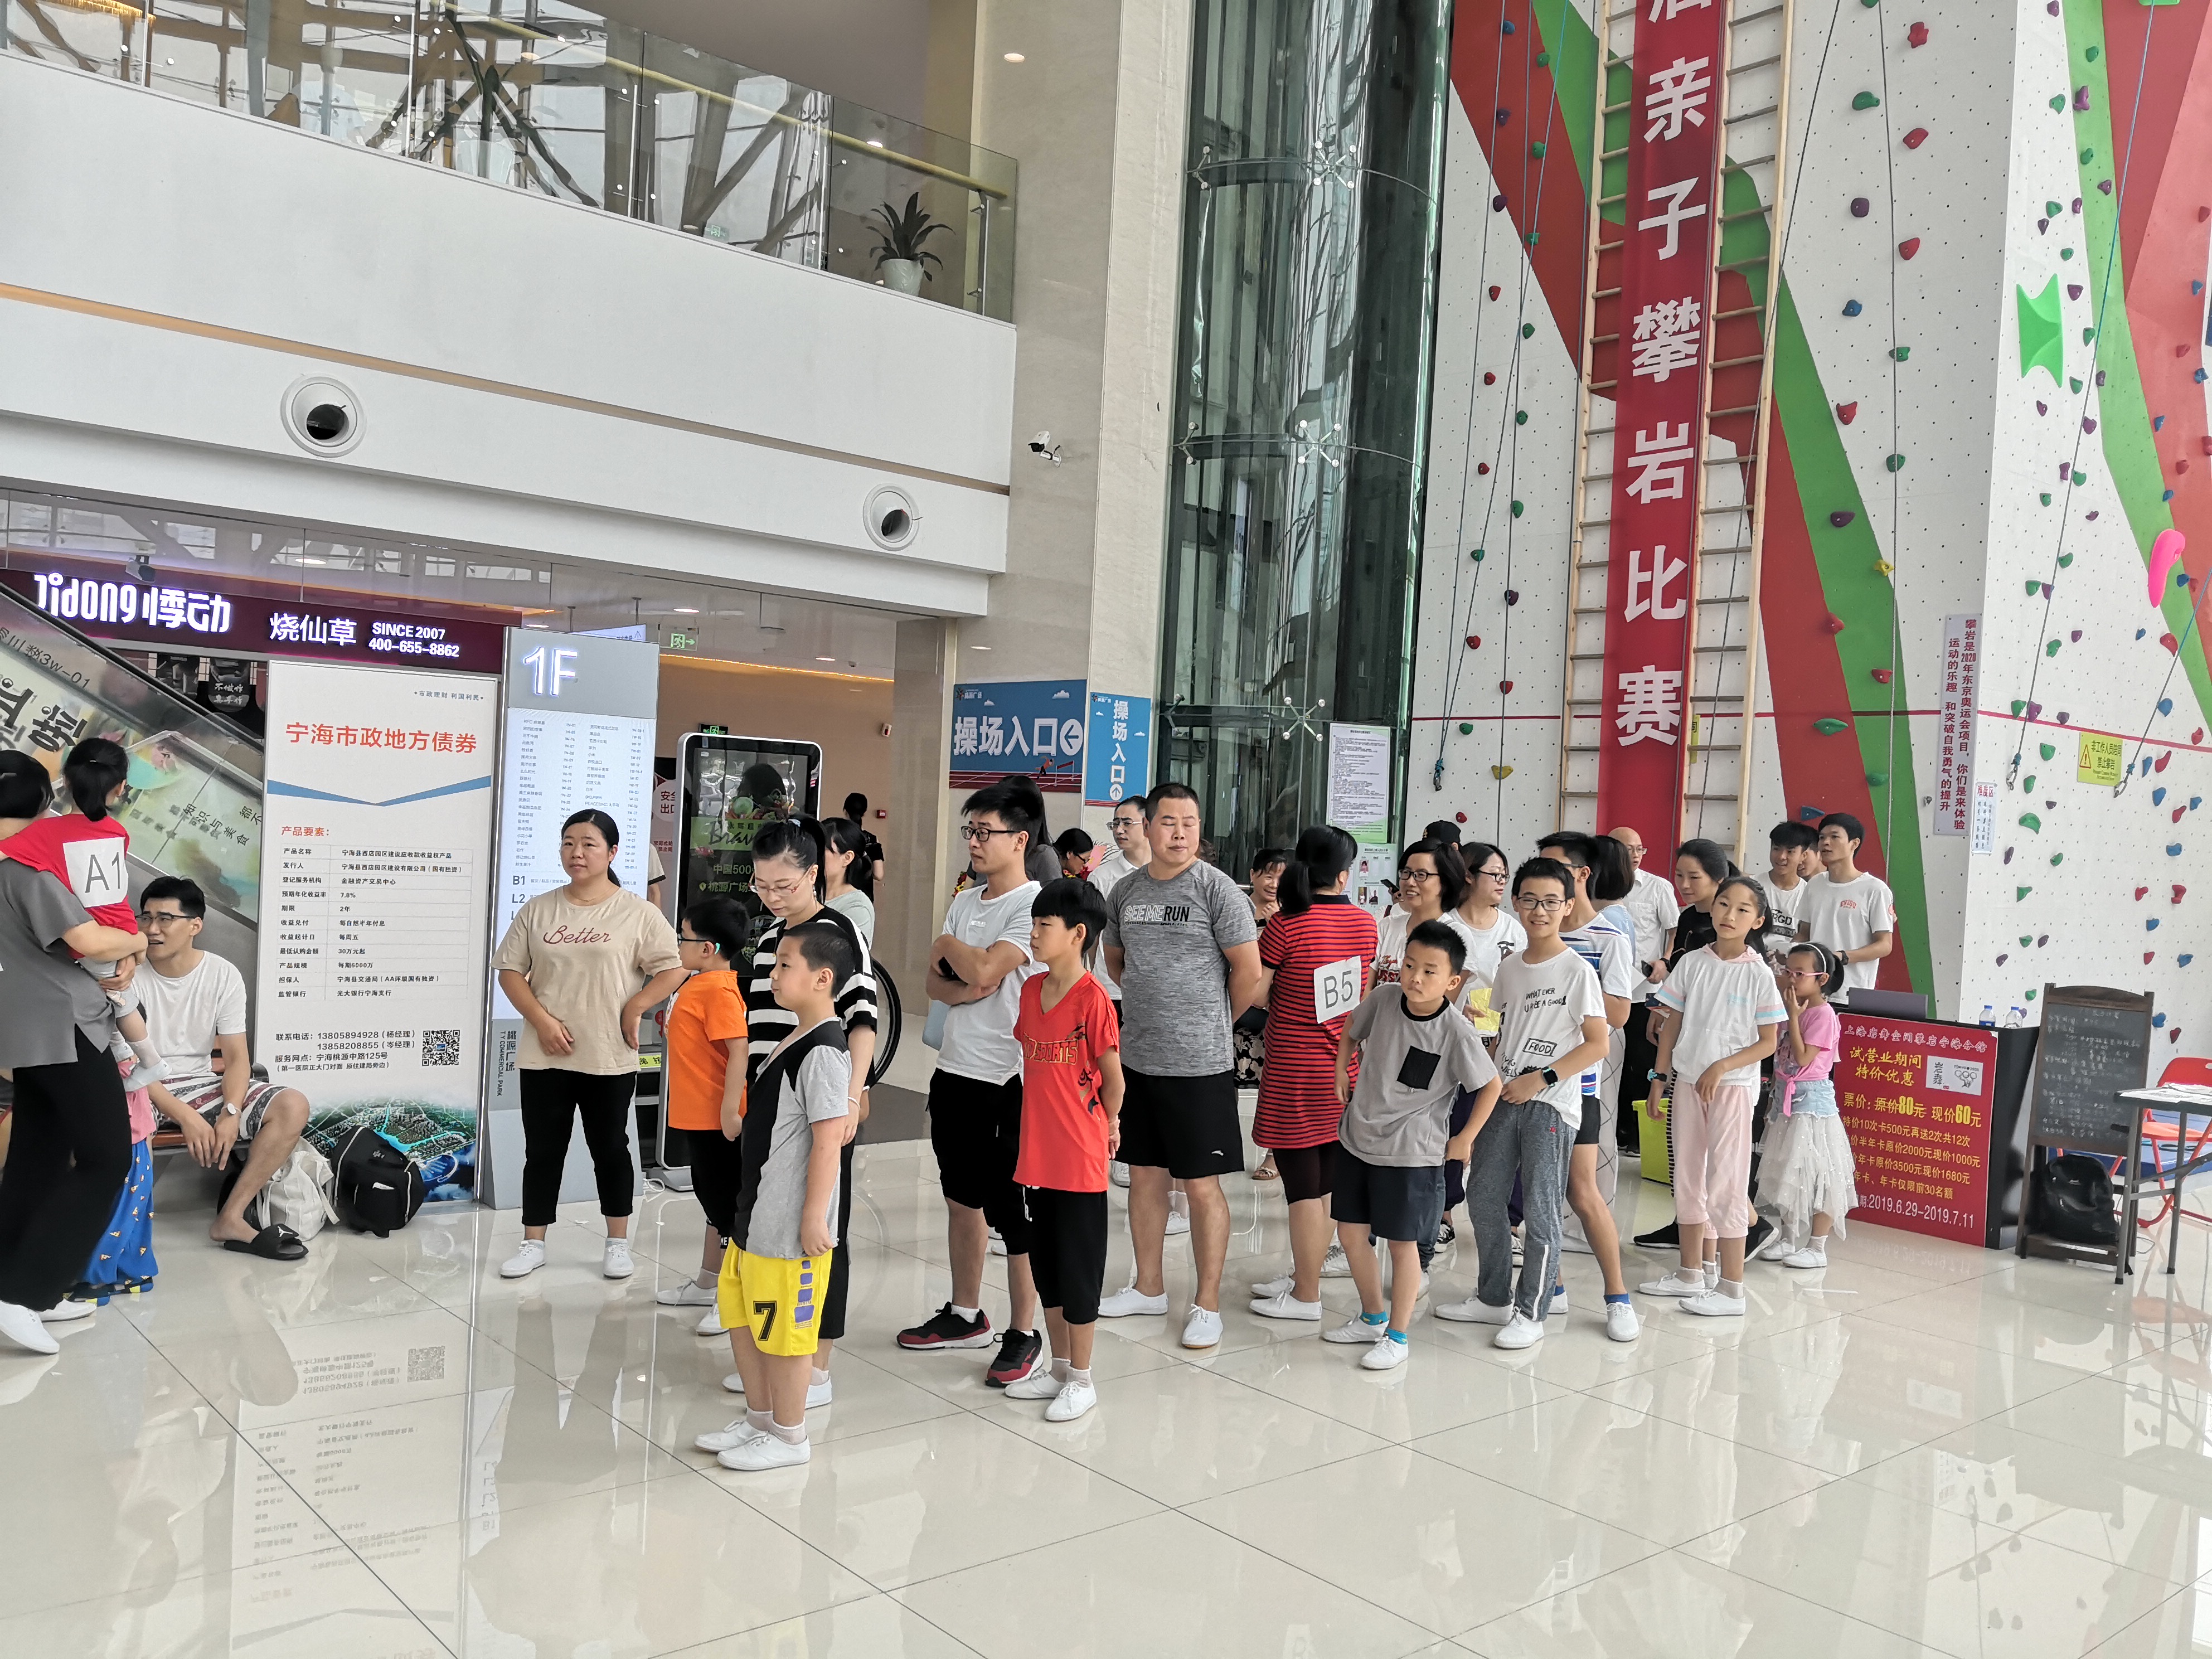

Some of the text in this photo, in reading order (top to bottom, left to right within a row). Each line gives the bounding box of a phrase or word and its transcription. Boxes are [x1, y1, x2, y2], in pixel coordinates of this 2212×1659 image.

[1616, 0, 1713, 746] 亲子攀岩比赛
[143, 585, 231, 633] 悸动
[269, 613, 357, 646] 烧仙草
[372, 622, 446, 641] SINCE 2007
[368, 638, 460, 658] 400-655-8862
[523, 646, 578, 696] 1F
[285, 722, 477, 754] 宁海市政地方债券
[953, 715, 1058, 756] 操场入口
[1939, 638, 1961, 811] 运动的乐趣 和突破自我勇气的提升
[1109, 700, 1128, 784] 操场入口
[1954, 764, 1968, 830] 你们是来体验
[84, 852, 124, 894] A1
[513, 875, 525, 885] B1
[713, 864, 754, 875] 中国500
[512, 894, 525, 904] L2
[709, 881, 751, 892] 桃源广场
[543, 925, 612, 944] Better
[1323, 970, 1353, 1008] B5
[1528, 1042, 1552, 1054] FOOD
[1850, 1046, 1922, 1069] 试营业期间
[1855, 1064, 1915, 1086] 特价优惠
[1932, 1104, 1981, 1128] 现价60元
[1849, 1134, 1981, 1168] 价半年卡原价2000元现价1000元
[1857, 1194, 1974, 1229] 期:2019.6.29-2019.7.11
[753, 1300, 777, 1341] 7
